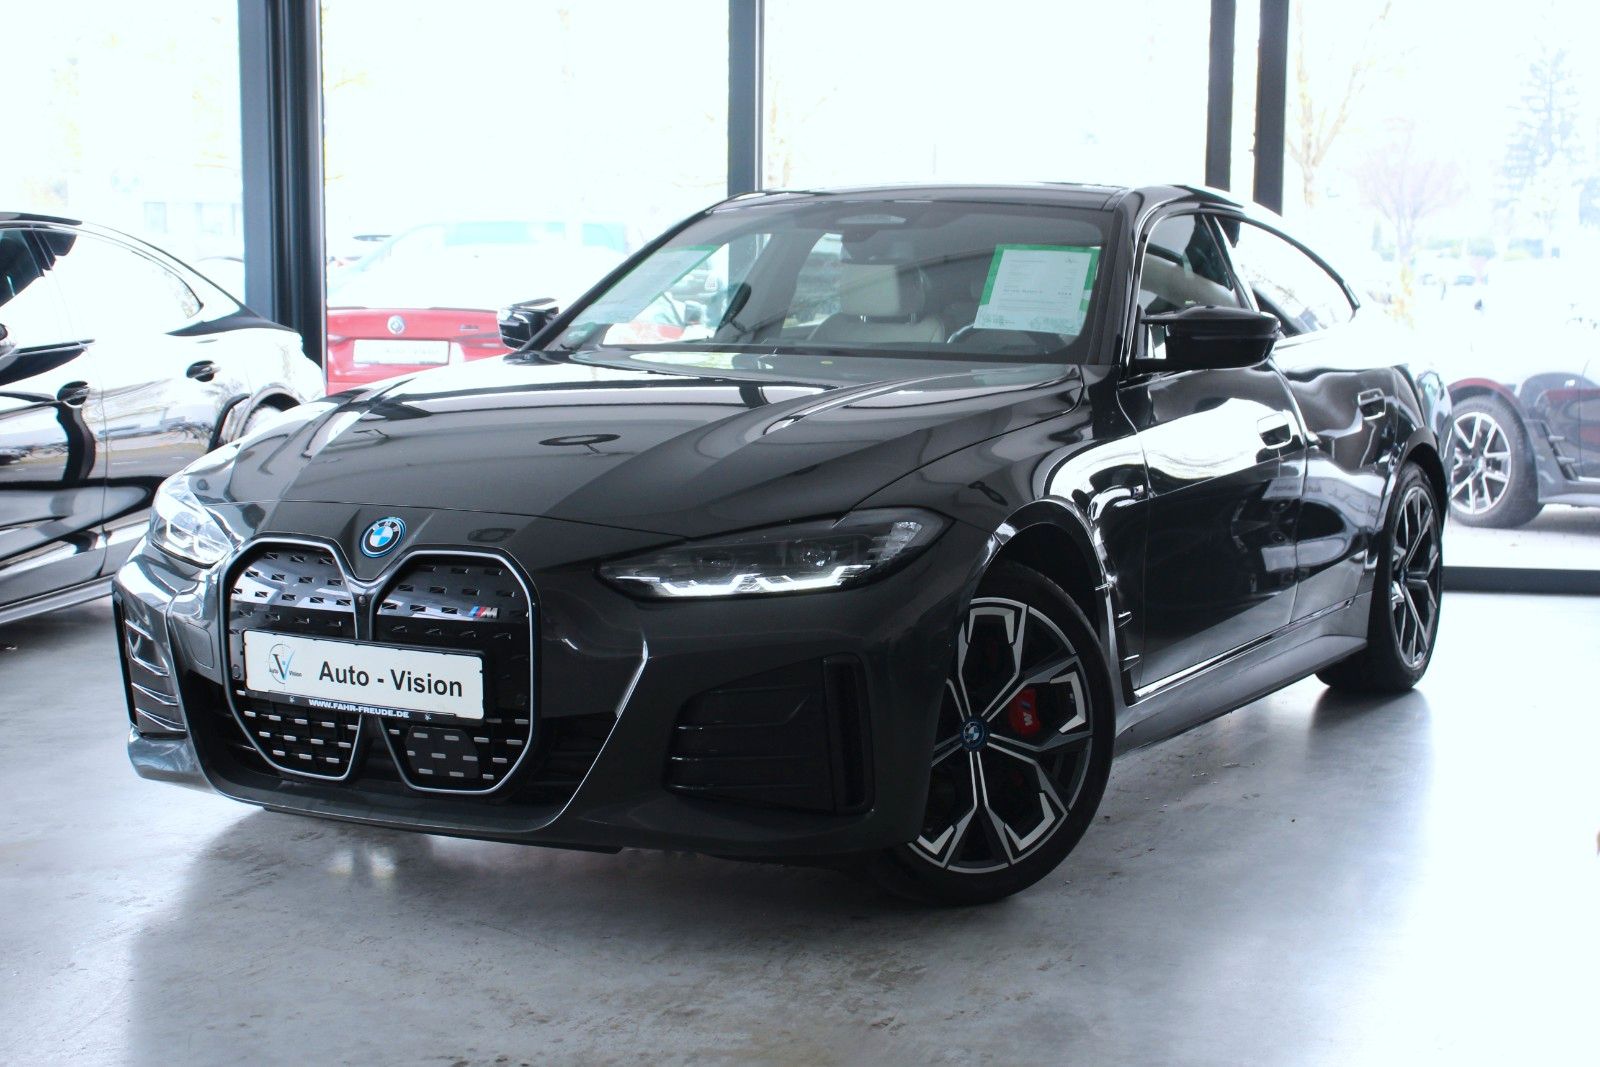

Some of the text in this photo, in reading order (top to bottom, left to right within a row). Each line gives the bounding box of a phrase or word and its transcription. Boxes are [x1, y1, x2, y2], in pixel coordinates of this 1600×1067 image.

[319, 660, 370, 687] Auto
[390, 668, 463, 698] Vision
[308, 698, 410, 718] WWW.FAHR-FREUDE.DE
